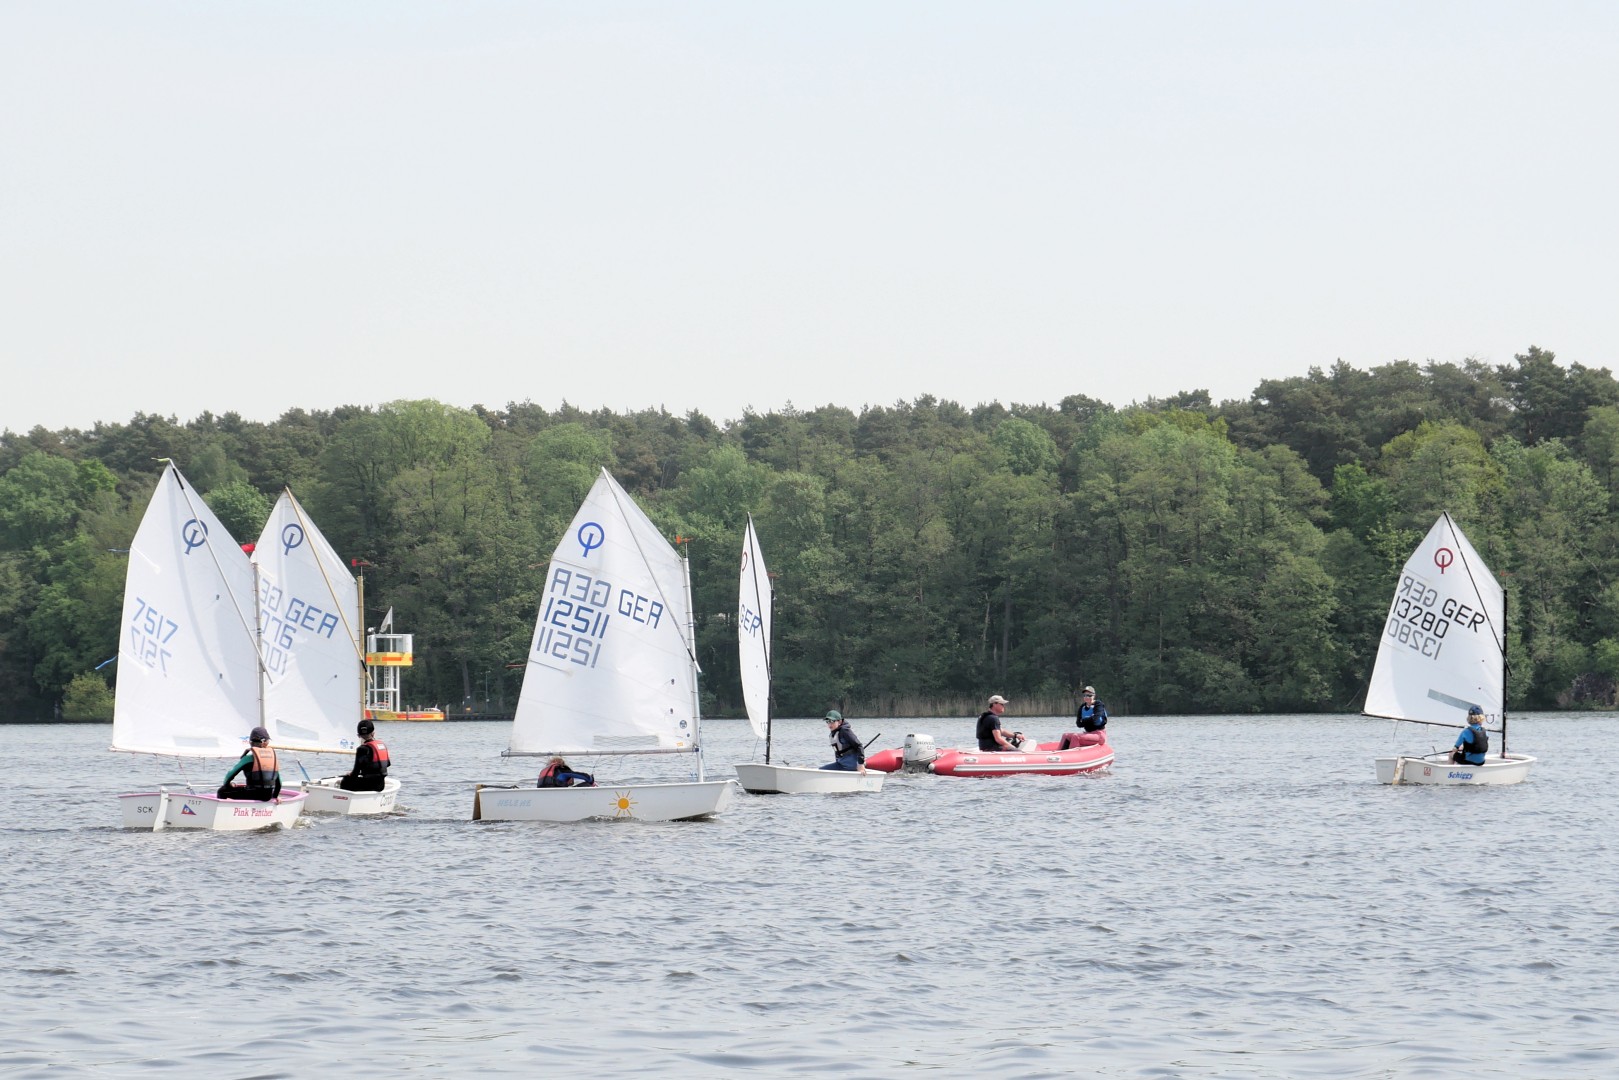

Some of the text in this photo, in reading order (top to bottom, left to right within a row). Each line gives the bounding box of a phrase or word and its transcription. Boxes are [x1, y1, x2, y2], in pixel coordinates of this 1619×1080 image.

[133, 596, 179, 644] 7517
[260, 609, 297, 650] 076
[543, 597, 610, 639] 12511
[740, 603, 762, 638] GER
[1393, 595, 1450, 639] 13280
[1442, 598, 1486, 633] GER
[137, 806, 154, 814] SCK
[233, 807, 274, 817] Pink Panther
